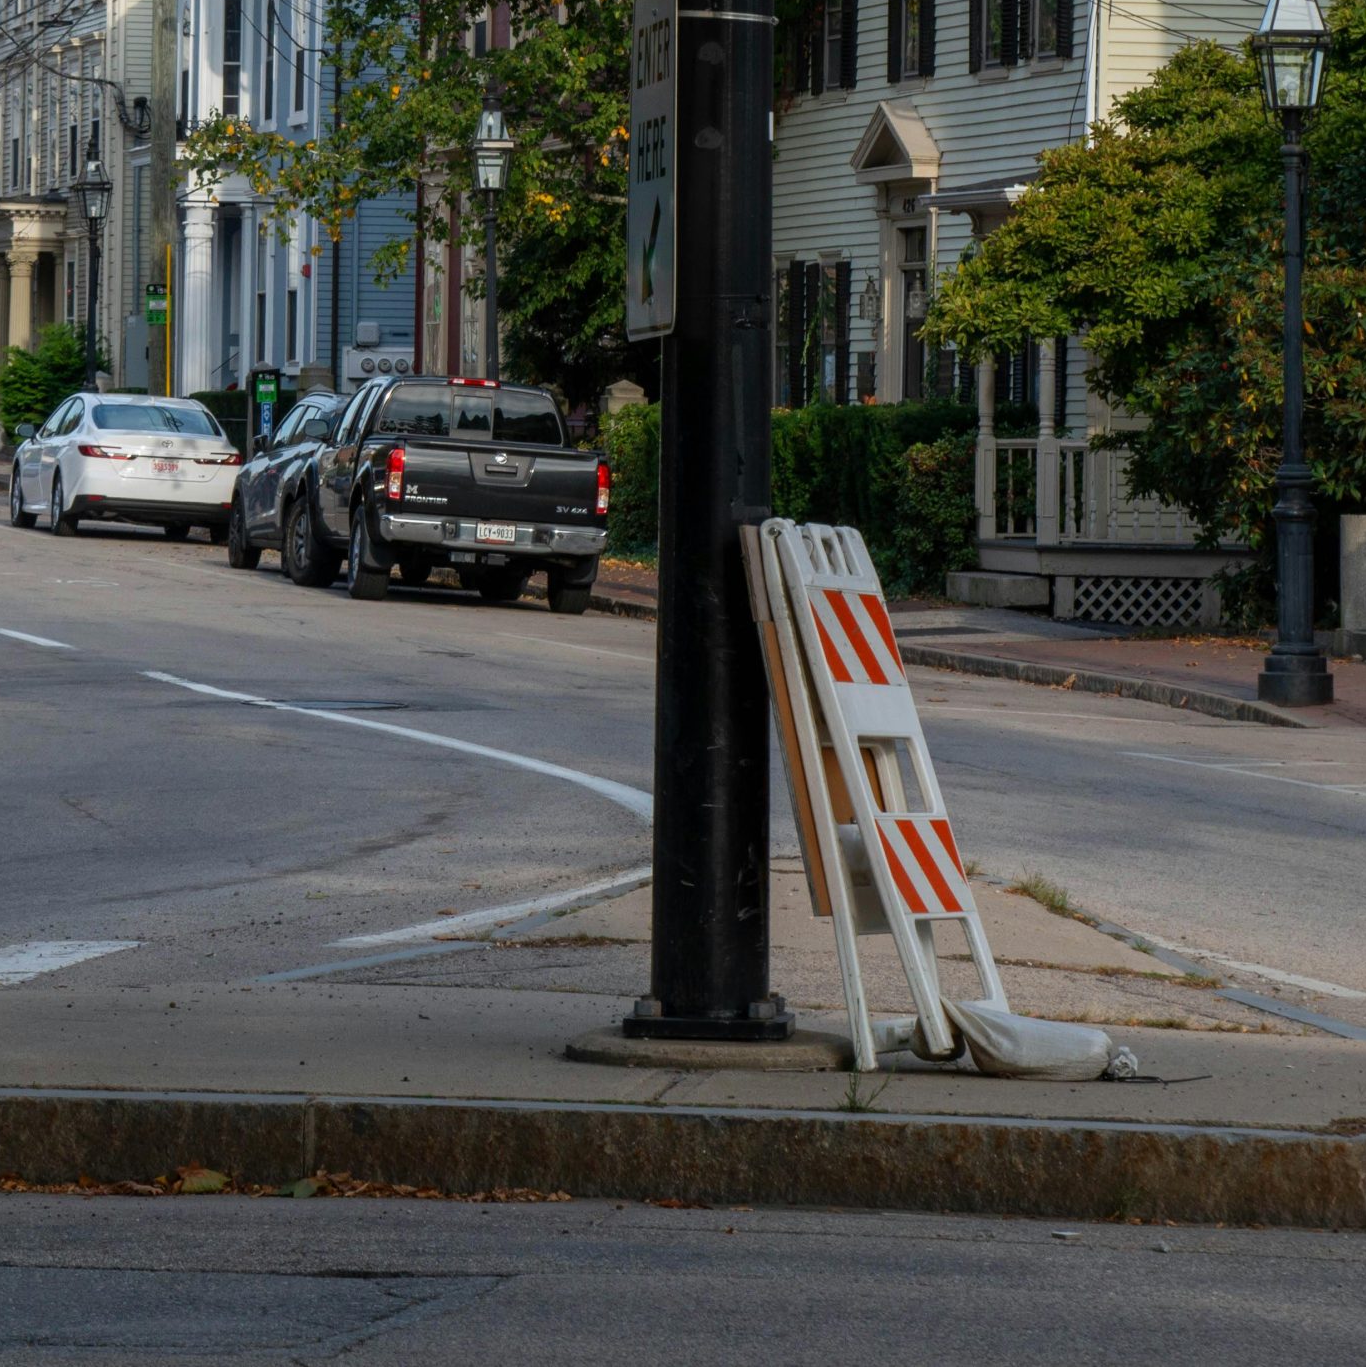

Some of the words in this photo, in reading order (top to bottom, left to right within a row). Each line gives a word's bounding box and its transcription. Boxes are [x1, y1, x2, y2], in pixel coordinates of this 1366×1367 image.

[637, 18, 670, 89] ENTER
[637, 115, 667, 184] HERE
[405, 485, 418, 495] M
[404, 495, 448, 505] FRONTIER
[556, 506, 570, 514] SV
